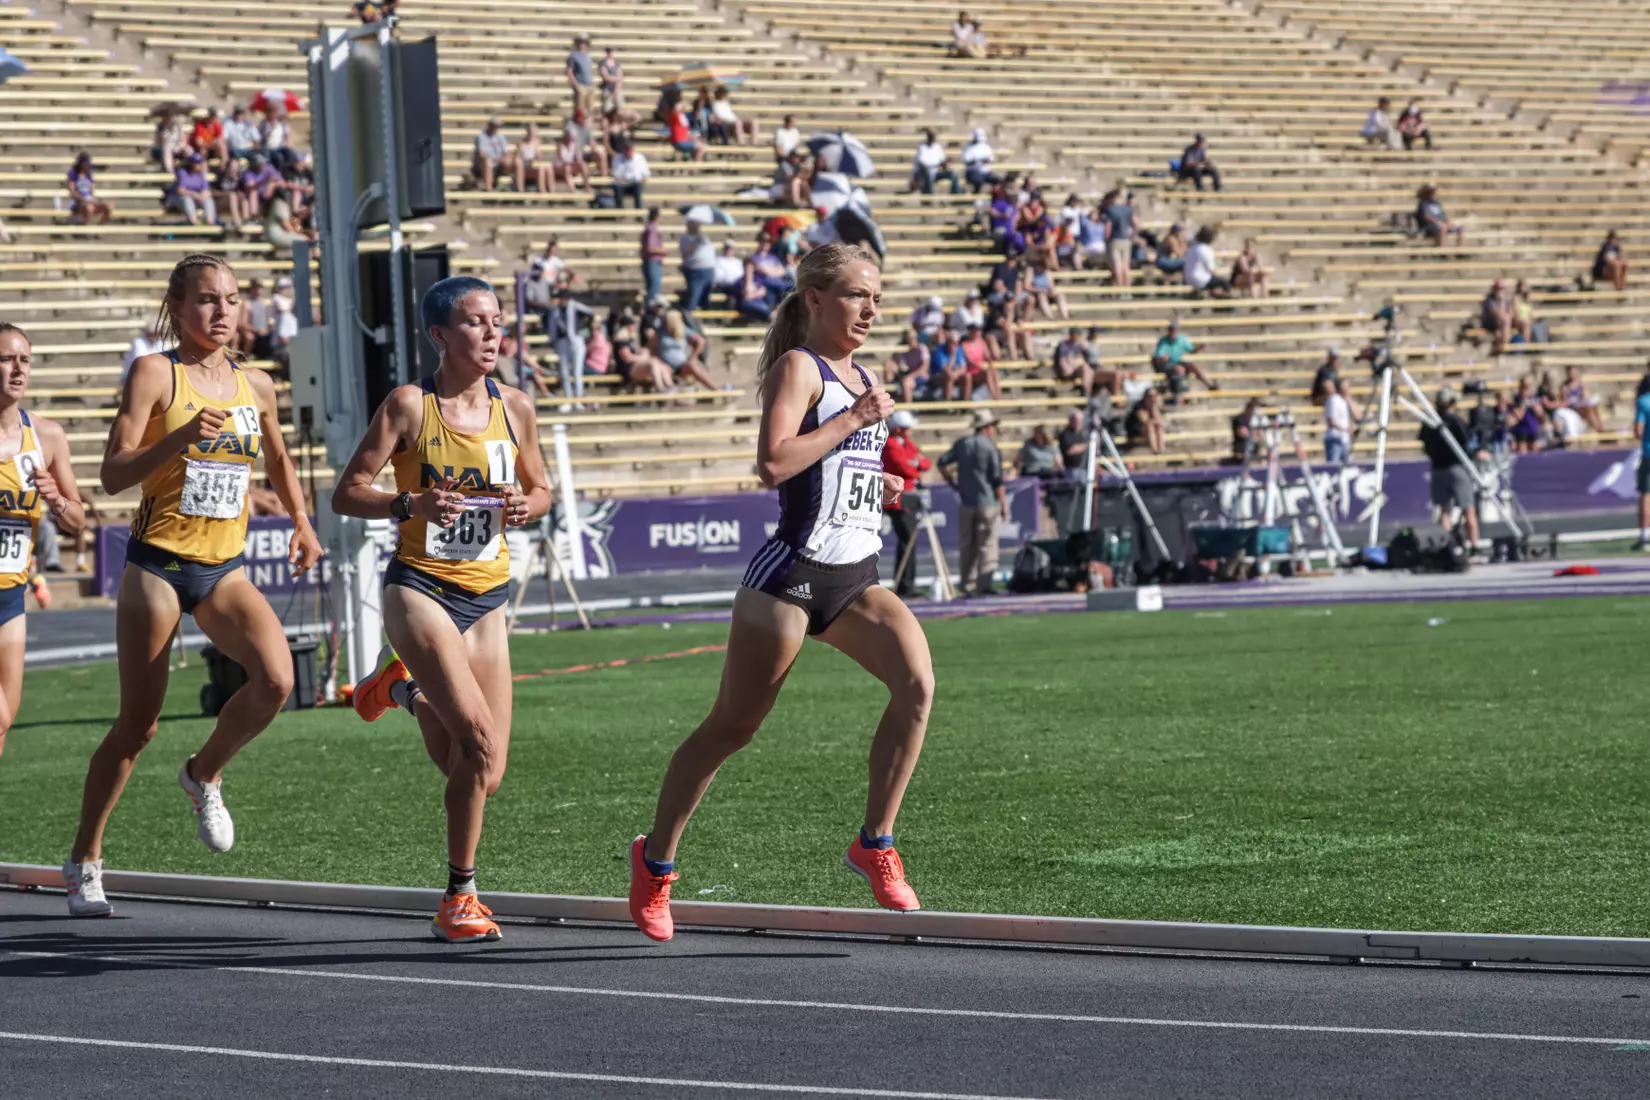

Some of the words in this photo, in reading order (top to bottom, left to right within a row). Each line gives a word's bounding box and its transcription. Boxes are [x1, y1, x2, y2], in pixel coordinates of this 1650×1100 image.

[238, 406, 259, 433] 13
[494, 443, 507, 482] 1
[0, 489, 39, 511] AU
[192, 471, 241, 505] 355
[0, 527, 24, 559] 65
[243, 529, 296, 560] WEB
[649, 516, 740, 549] FUSION
[786, 588, 813, 600] adidas
